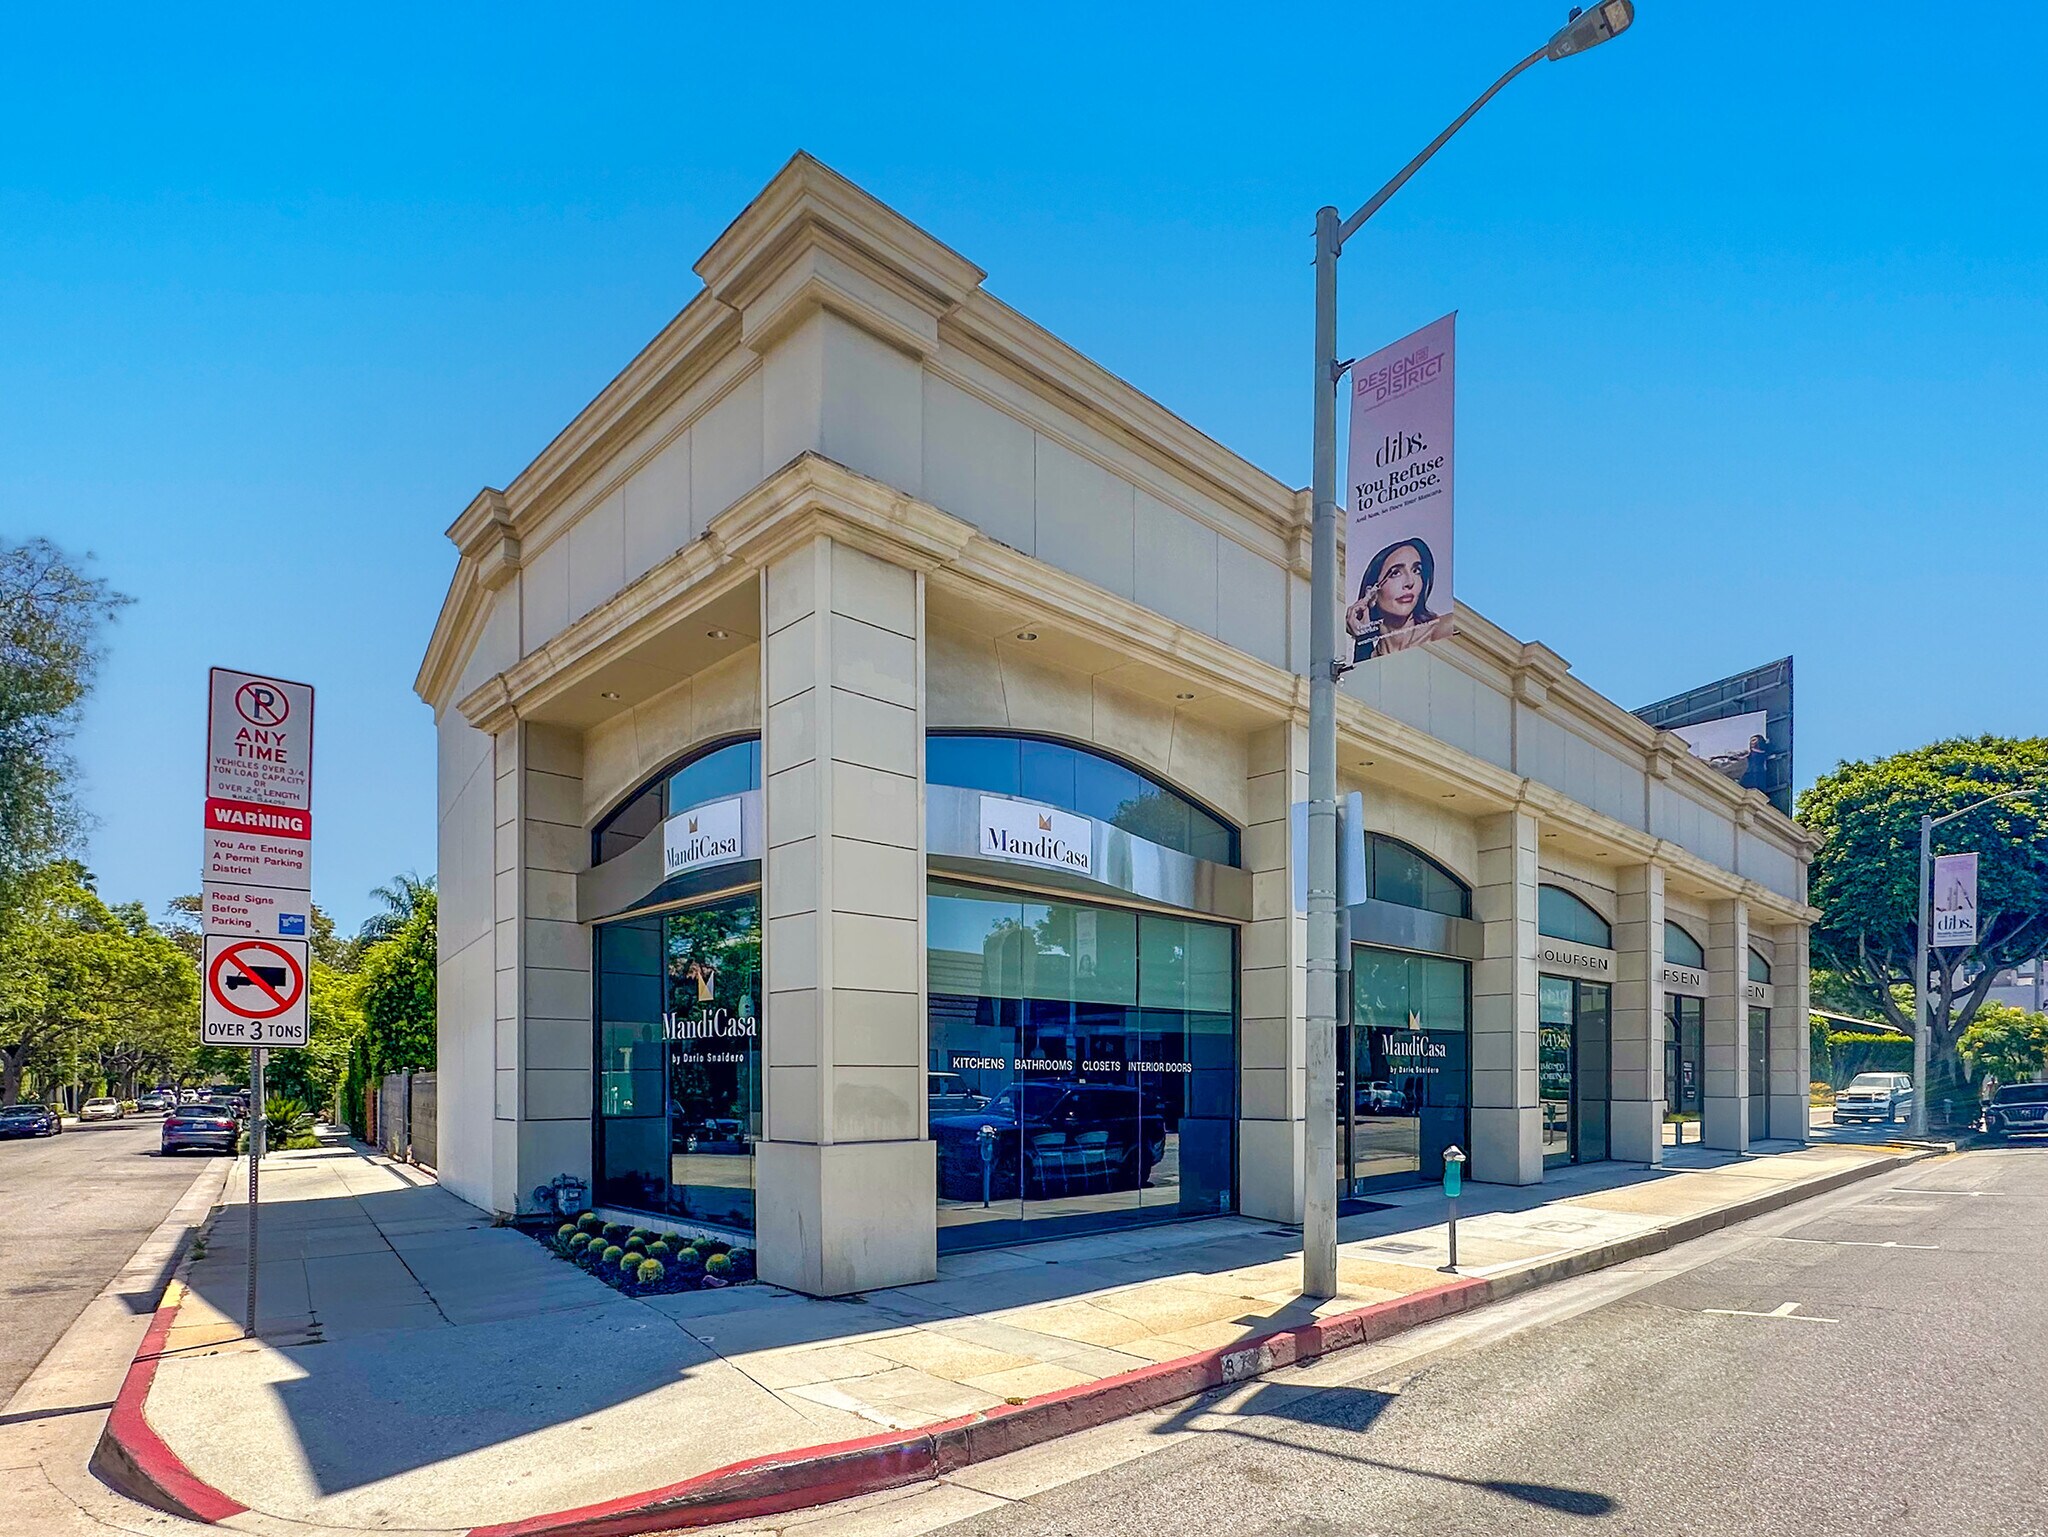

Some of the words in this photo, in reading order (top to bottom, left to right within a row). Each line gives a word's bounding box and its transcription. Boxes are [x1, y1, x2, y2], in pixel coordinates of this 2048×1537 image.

[1358, 353, 1415, 392] DESIGN
[1376, 354, 1444, 401] DISTRICT
[1376, 431, 1427, 467] dibs.
[1356, 479, 1384, 497] You
[1389, 456, 1444, 485] Refuse
[1358, 498, 1373, 511] to
[1378, 474, 1440, 503] Choose.
[235, 727, 286, 746] ANY
[234, 743, 287, 763] TIME
[213, 765, 231, 774] TON
[235, 769, 259, 778] LOAD
[262, 773, 305, 785] CAPACITY
[216, 757, 259, 770] VEHICLES
[262, 764, 285, 774] OVER
[288, 769, 304, 777] 3/4
[218, 782, 242, 792] OVER
[264, 789, 300, 800] LENGTH
[254, 780, 266, 788] OR
[214, 807, 304, 831] WARNING
[213, 839, 233, 850] You
[237, 842, 256, 851] Are
[260, 844, 304, 858] Entering
[667, 835, 736, 868] MandiCasa
[988, 827, 1088, 868] MandiCasa
[212, 864, 252, 875] District
[213, 852, 221, 860] A
[226, 853, 260, 864] Permit
[264, 857, 302, 869] Parking
[212, 892, 240, 902] Read
[245, 894, 274, 905] Signs
[212, 904, 249, 915] Before
[212, 916, 252, 928] Parking
[1938, 915, 1973, 930] dibs.
[1544, 950, 1608, 970] OLUFSEN
[208, 1022, 245, 1036] OVER
[250, 1020, 263, 1041] 3
[268, 1024, 302, 1038] TONS
[662, 1008, 757, 1040] MandiCasa
[1381, 1034, 1446, 1057] MandiCasa
[672, 1054, 680, 1065] by
[683, 1053, 704, 1062] Dario
[707, 1052, 744, 1062] Snaidero
[952, 1057, 1005, 1070] KITCHENS
[1014, 1058, 1073, 1071] BATHROOMS
[1082, 1060, 1121, 1071] CLOSETS
[1128, 1061, 1164, 1072] INTERIOR
[1165, 1062, 1192, 1073] DOORS
[1390, 1065, 1397, 1075] by
